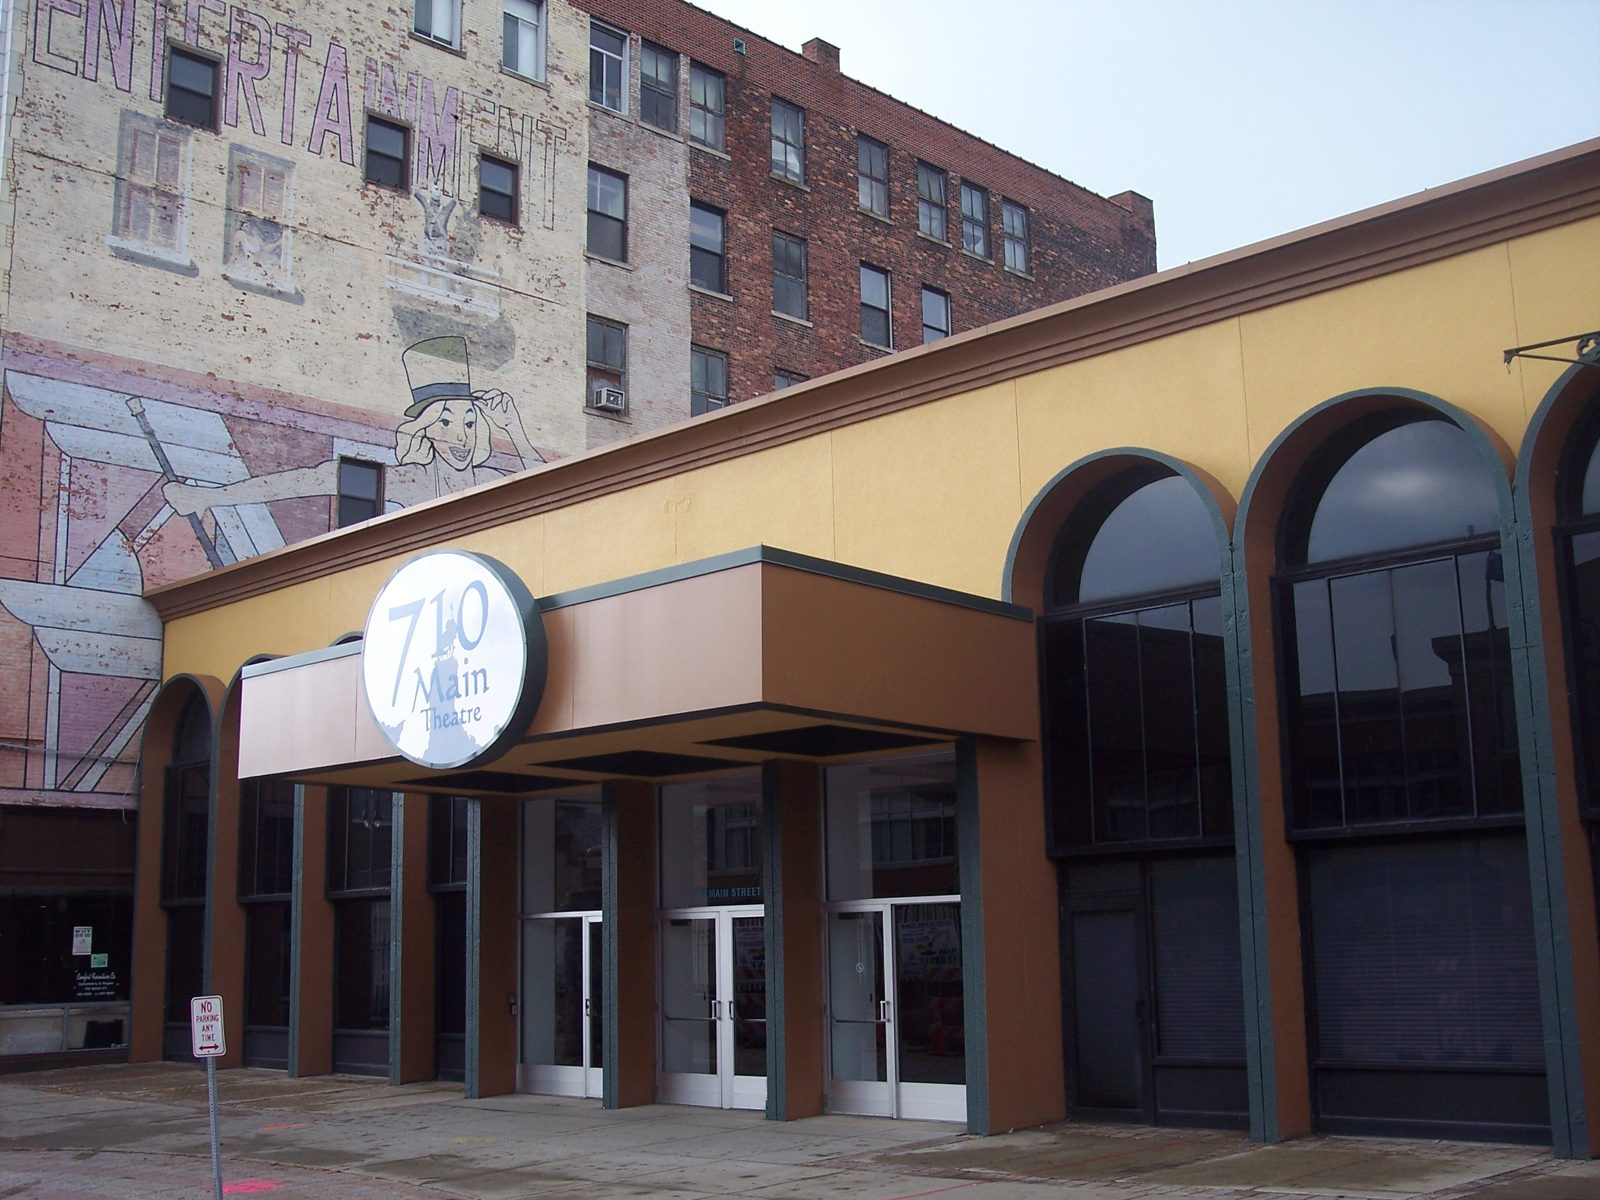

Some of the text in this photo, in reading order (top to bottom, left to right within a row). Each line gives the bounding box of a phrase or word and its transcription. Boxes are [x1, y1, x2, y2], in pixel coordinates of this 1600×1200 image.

[389, 580, 489, 707] 710
[411, 658, 489, 713] Main
[420, 706, 482, 732] Theatre
[708, 888, 729, 897] MAIN
[731, 886, 761, 897] STREET
[201, 1001, 212, 1013] NO
[196, 1014, 219, 1022] PARKING
[202, 1024, 214, 1032] ANY
[202, 1033, 215, 1042] TIME
